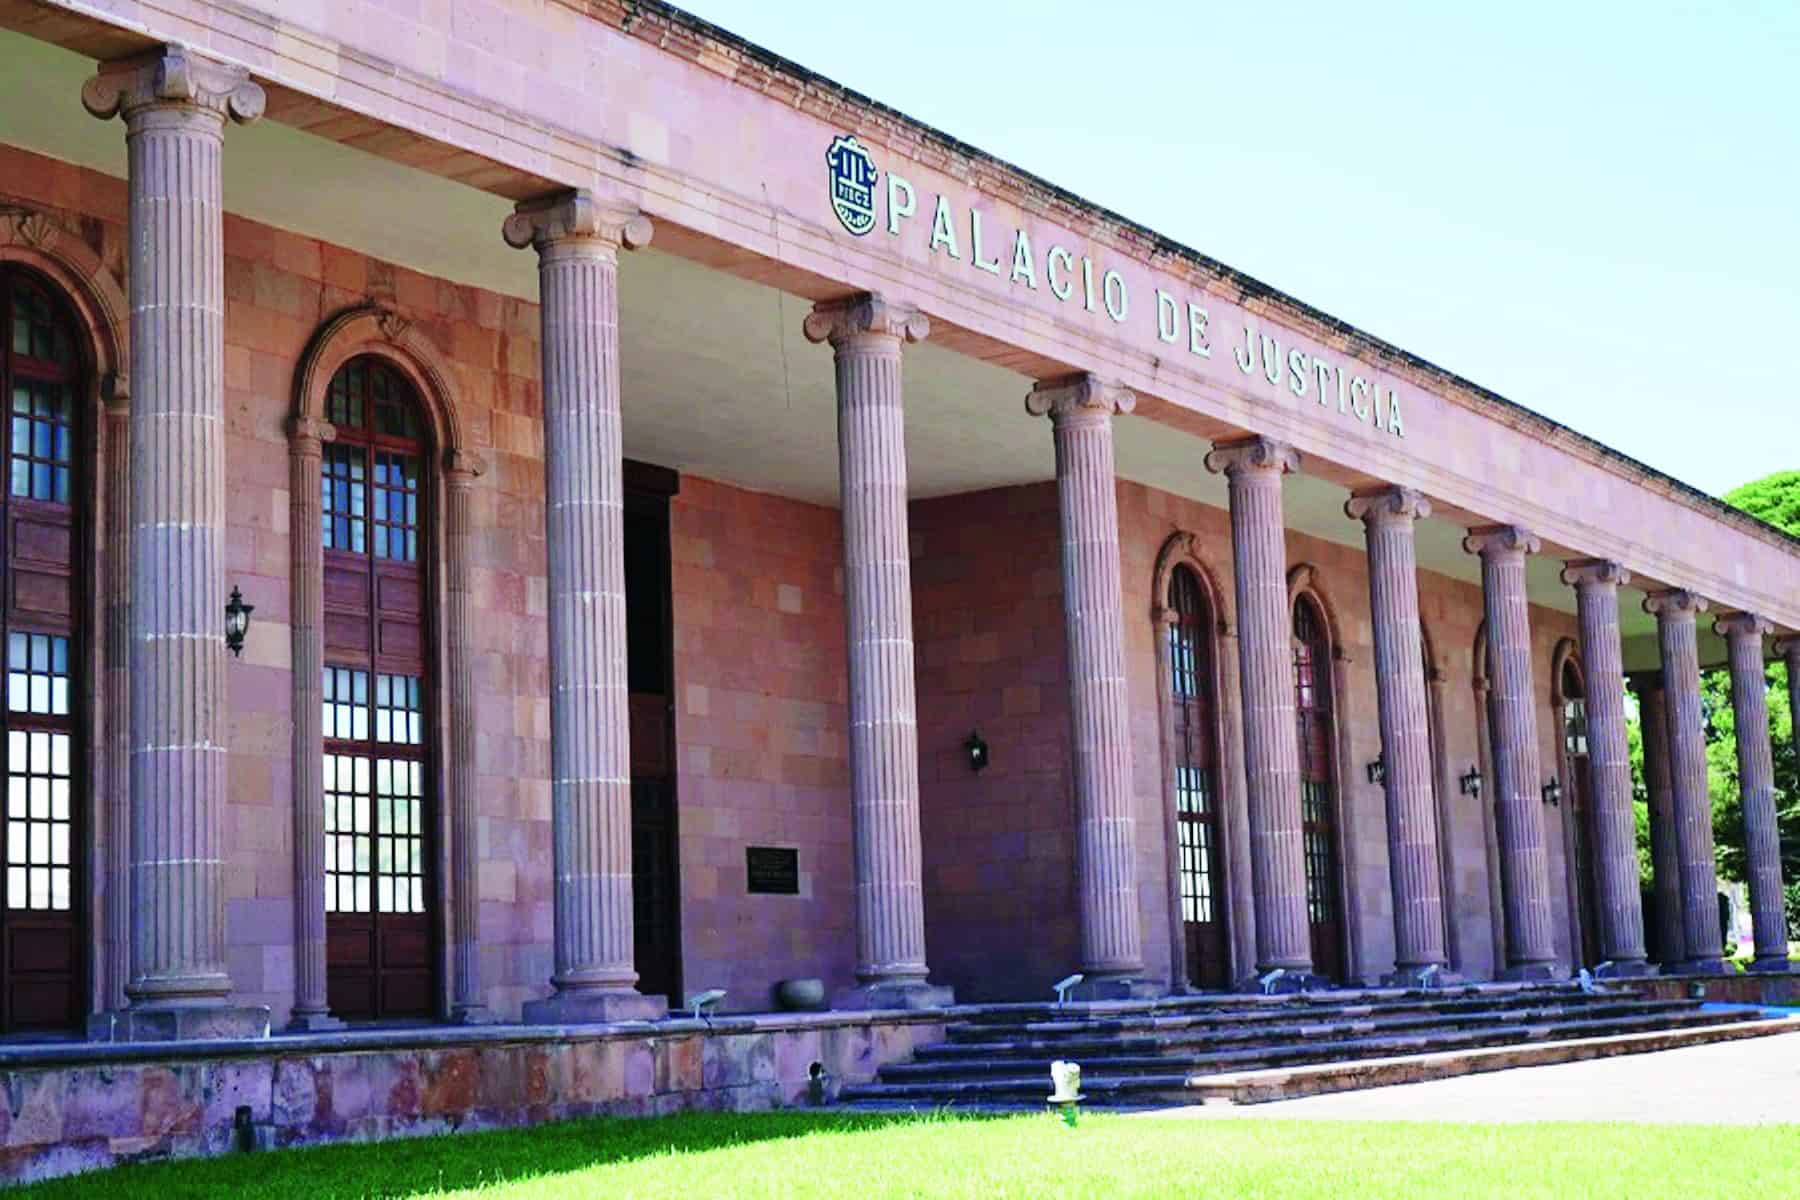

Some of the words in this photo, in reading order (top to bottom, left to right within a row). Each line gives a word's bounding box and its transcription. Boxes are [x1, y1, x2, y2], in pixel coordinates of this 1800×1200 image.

[885, 172, 1129, 323] PALACIO
[1156, 289, 1211, 358] DE
[1234, 328, 1405, 438] JUSTICIA
